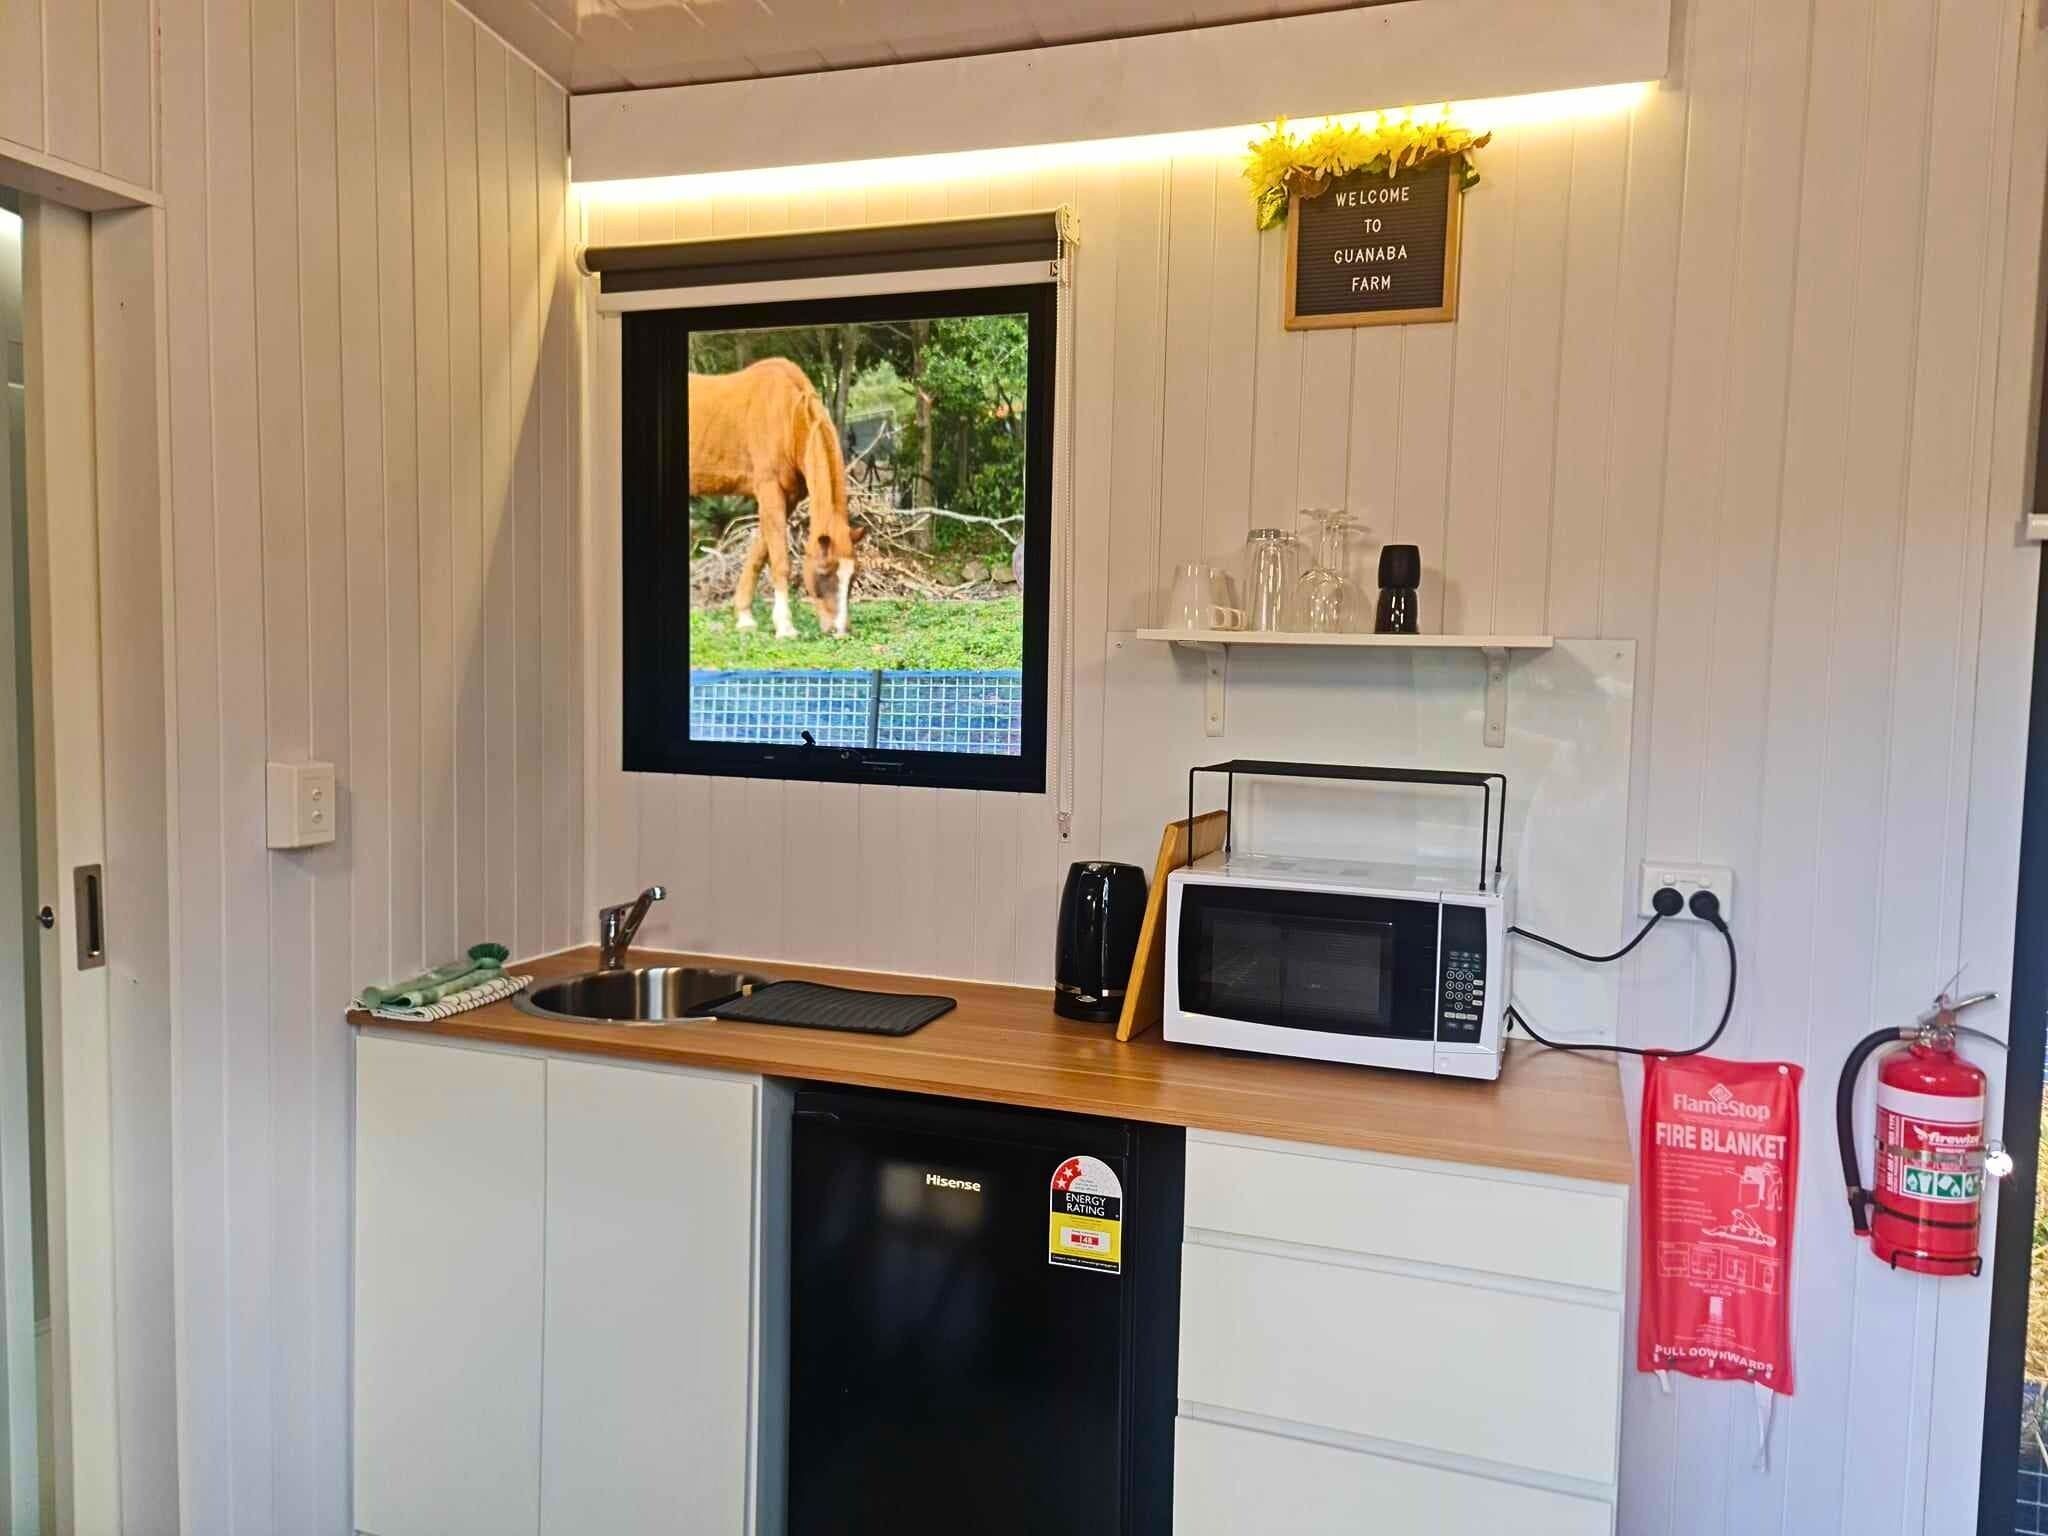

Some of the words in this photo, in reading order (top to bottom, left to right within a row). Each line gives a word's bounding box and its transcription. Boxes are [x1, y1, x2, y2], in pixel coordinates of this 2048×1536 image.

[1336, 186, 1410, 207] WELCOME
[1364, 218, 1382, 233] TO
[1334, 244, 1408, 264] GUANABA
[1351, 275, 1392, 293] FARM
[1673, 1093, 1771, 1122] FlameStop
[1656, 1122, 1697, 1150] FIRE
[1700, 1127, 1787, 1160] BLANKET
[926, 1173, 981, 1192] Hisense
[1065, 1192, 1106, 1207] ENERGY
[1066, 1204, 1105, 1217] RATING
[1654, 1344, 1686, 1357] PULL
[1689, 1347, 1774, 1373] DOWNWARDS
